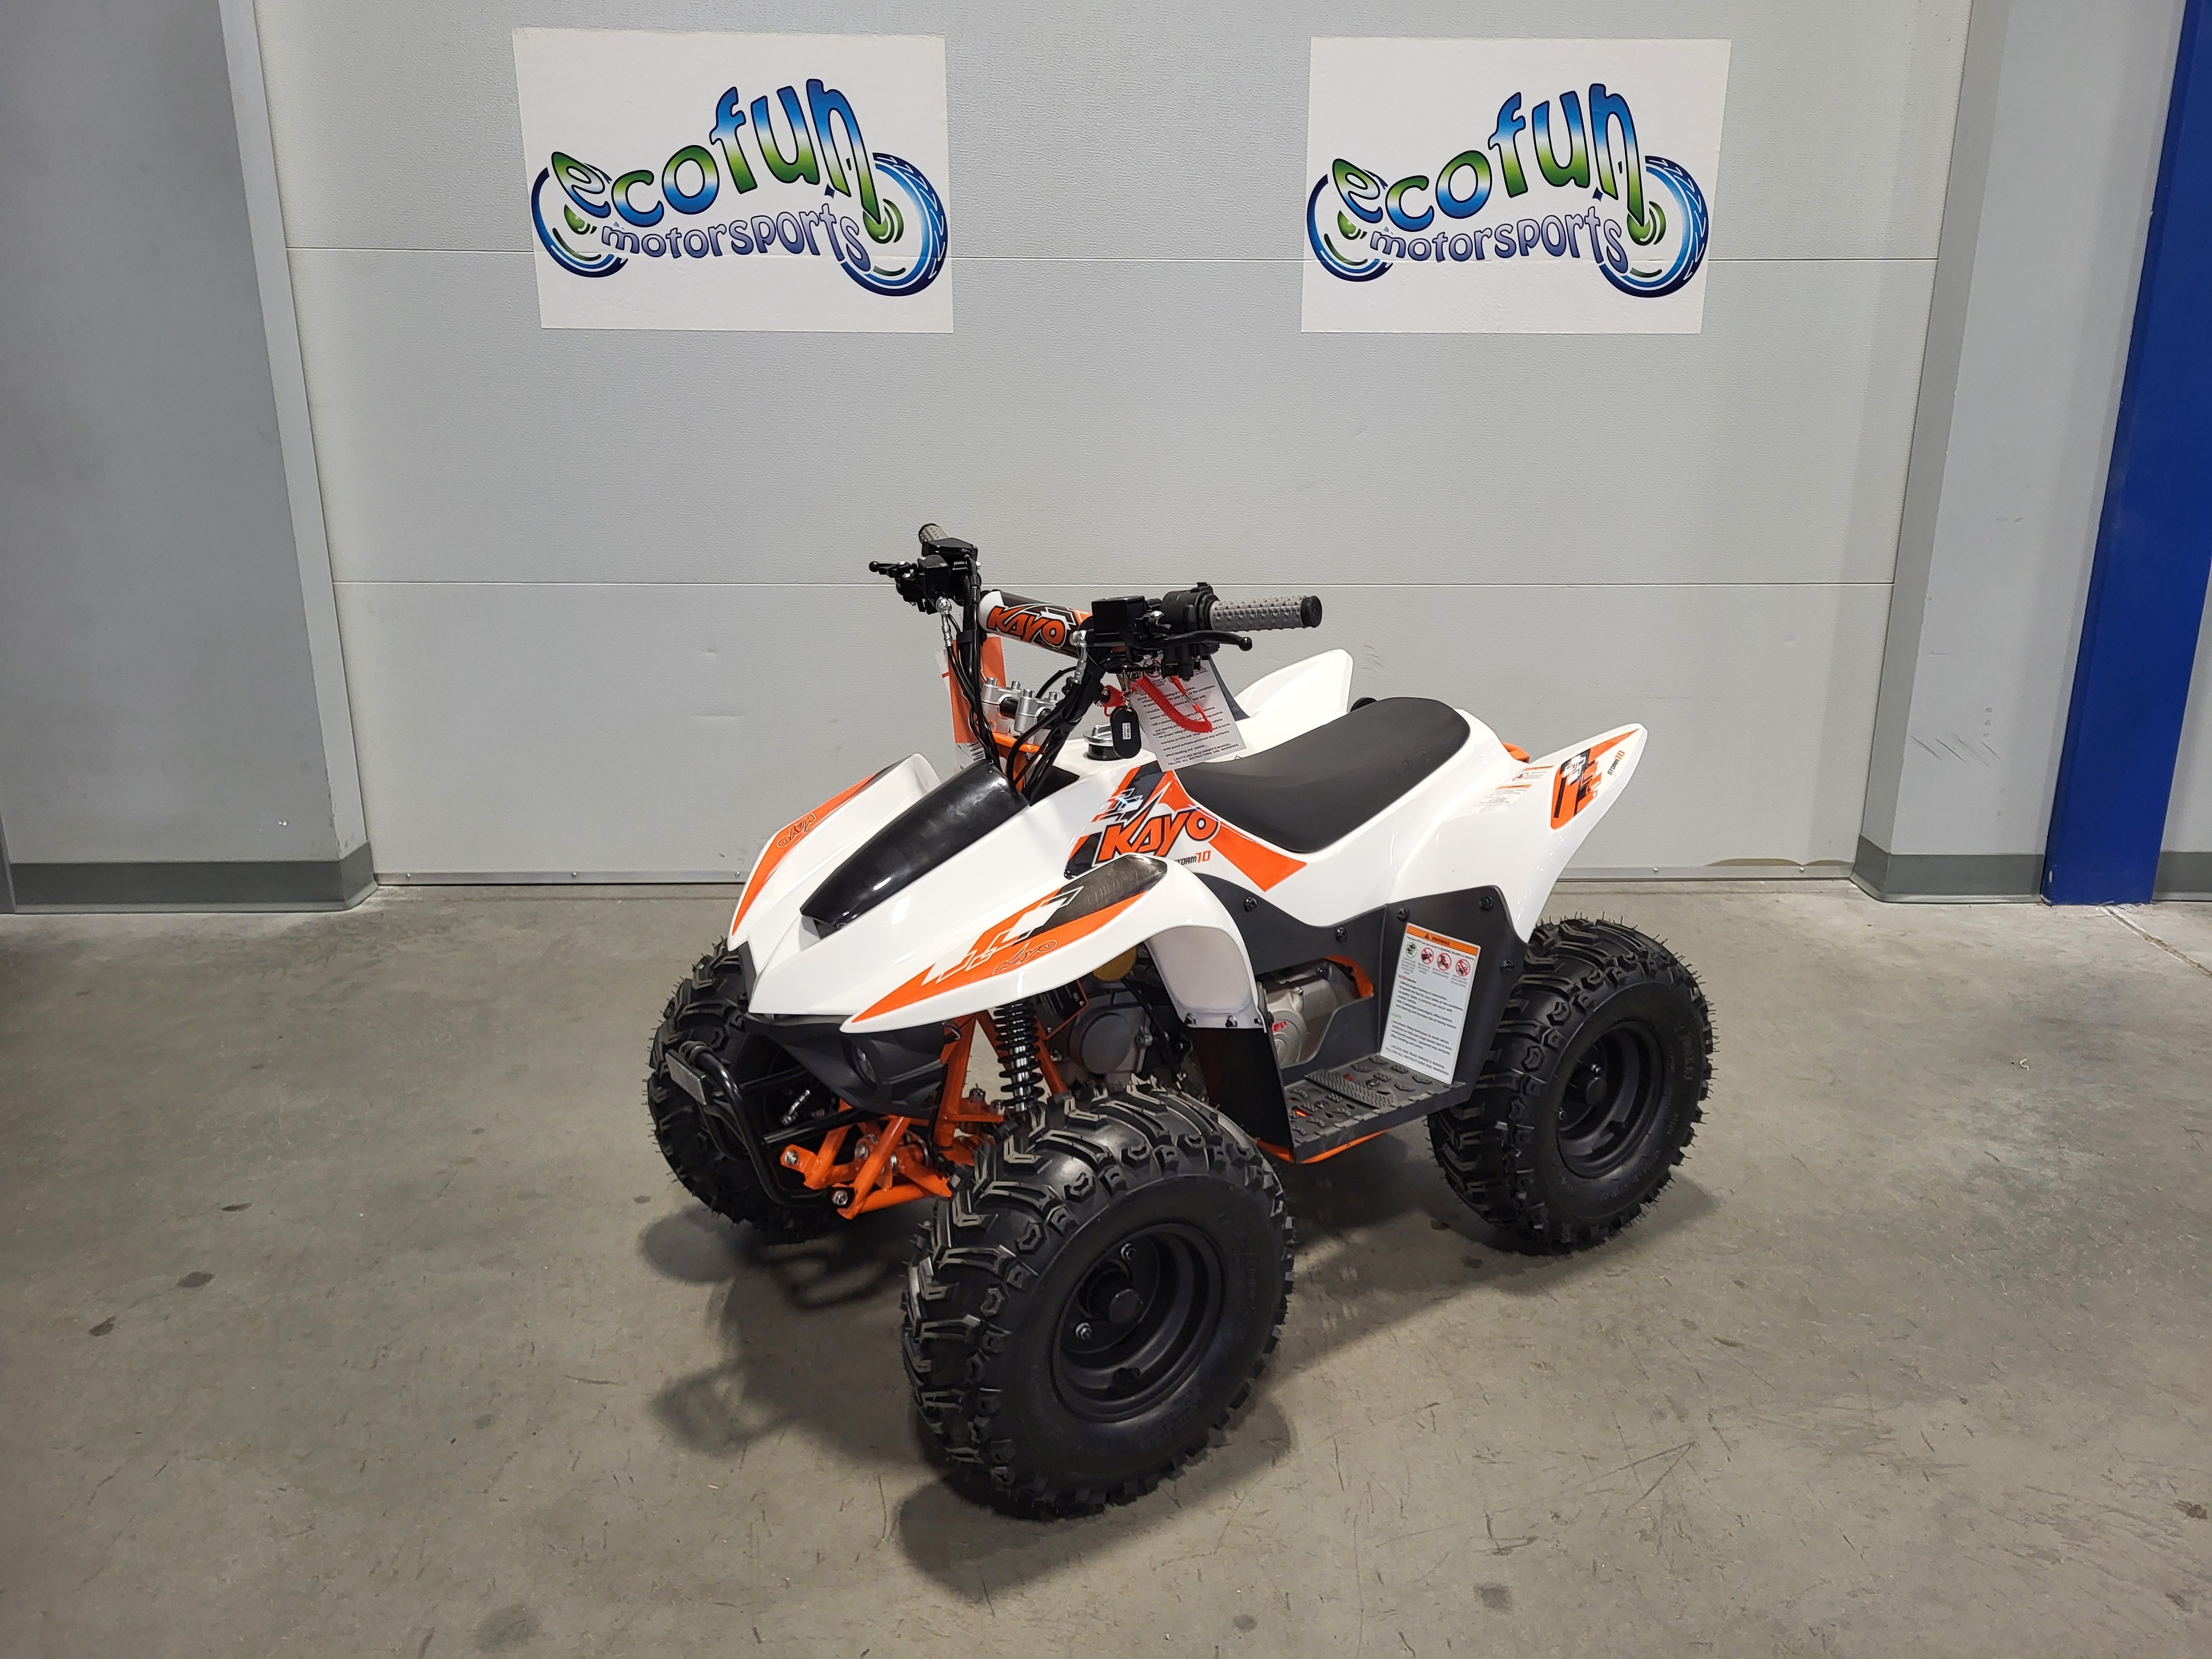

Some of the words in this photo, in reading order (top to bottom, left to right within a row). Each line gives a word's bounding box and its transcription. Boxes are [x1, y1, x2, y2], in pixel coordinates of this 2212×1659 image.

[552, 79, 881, 225] ecofun
[1332, 83, 1645, 226] ecofun
[601, 203, 871, 273] motorsports
[1370, 206, 1630, 274] motorsports
[986, 605, 1067, 648] KAYO
[778, 812, 816, 848] KAYO
[1094, 805, 1219, 865] KAYO
